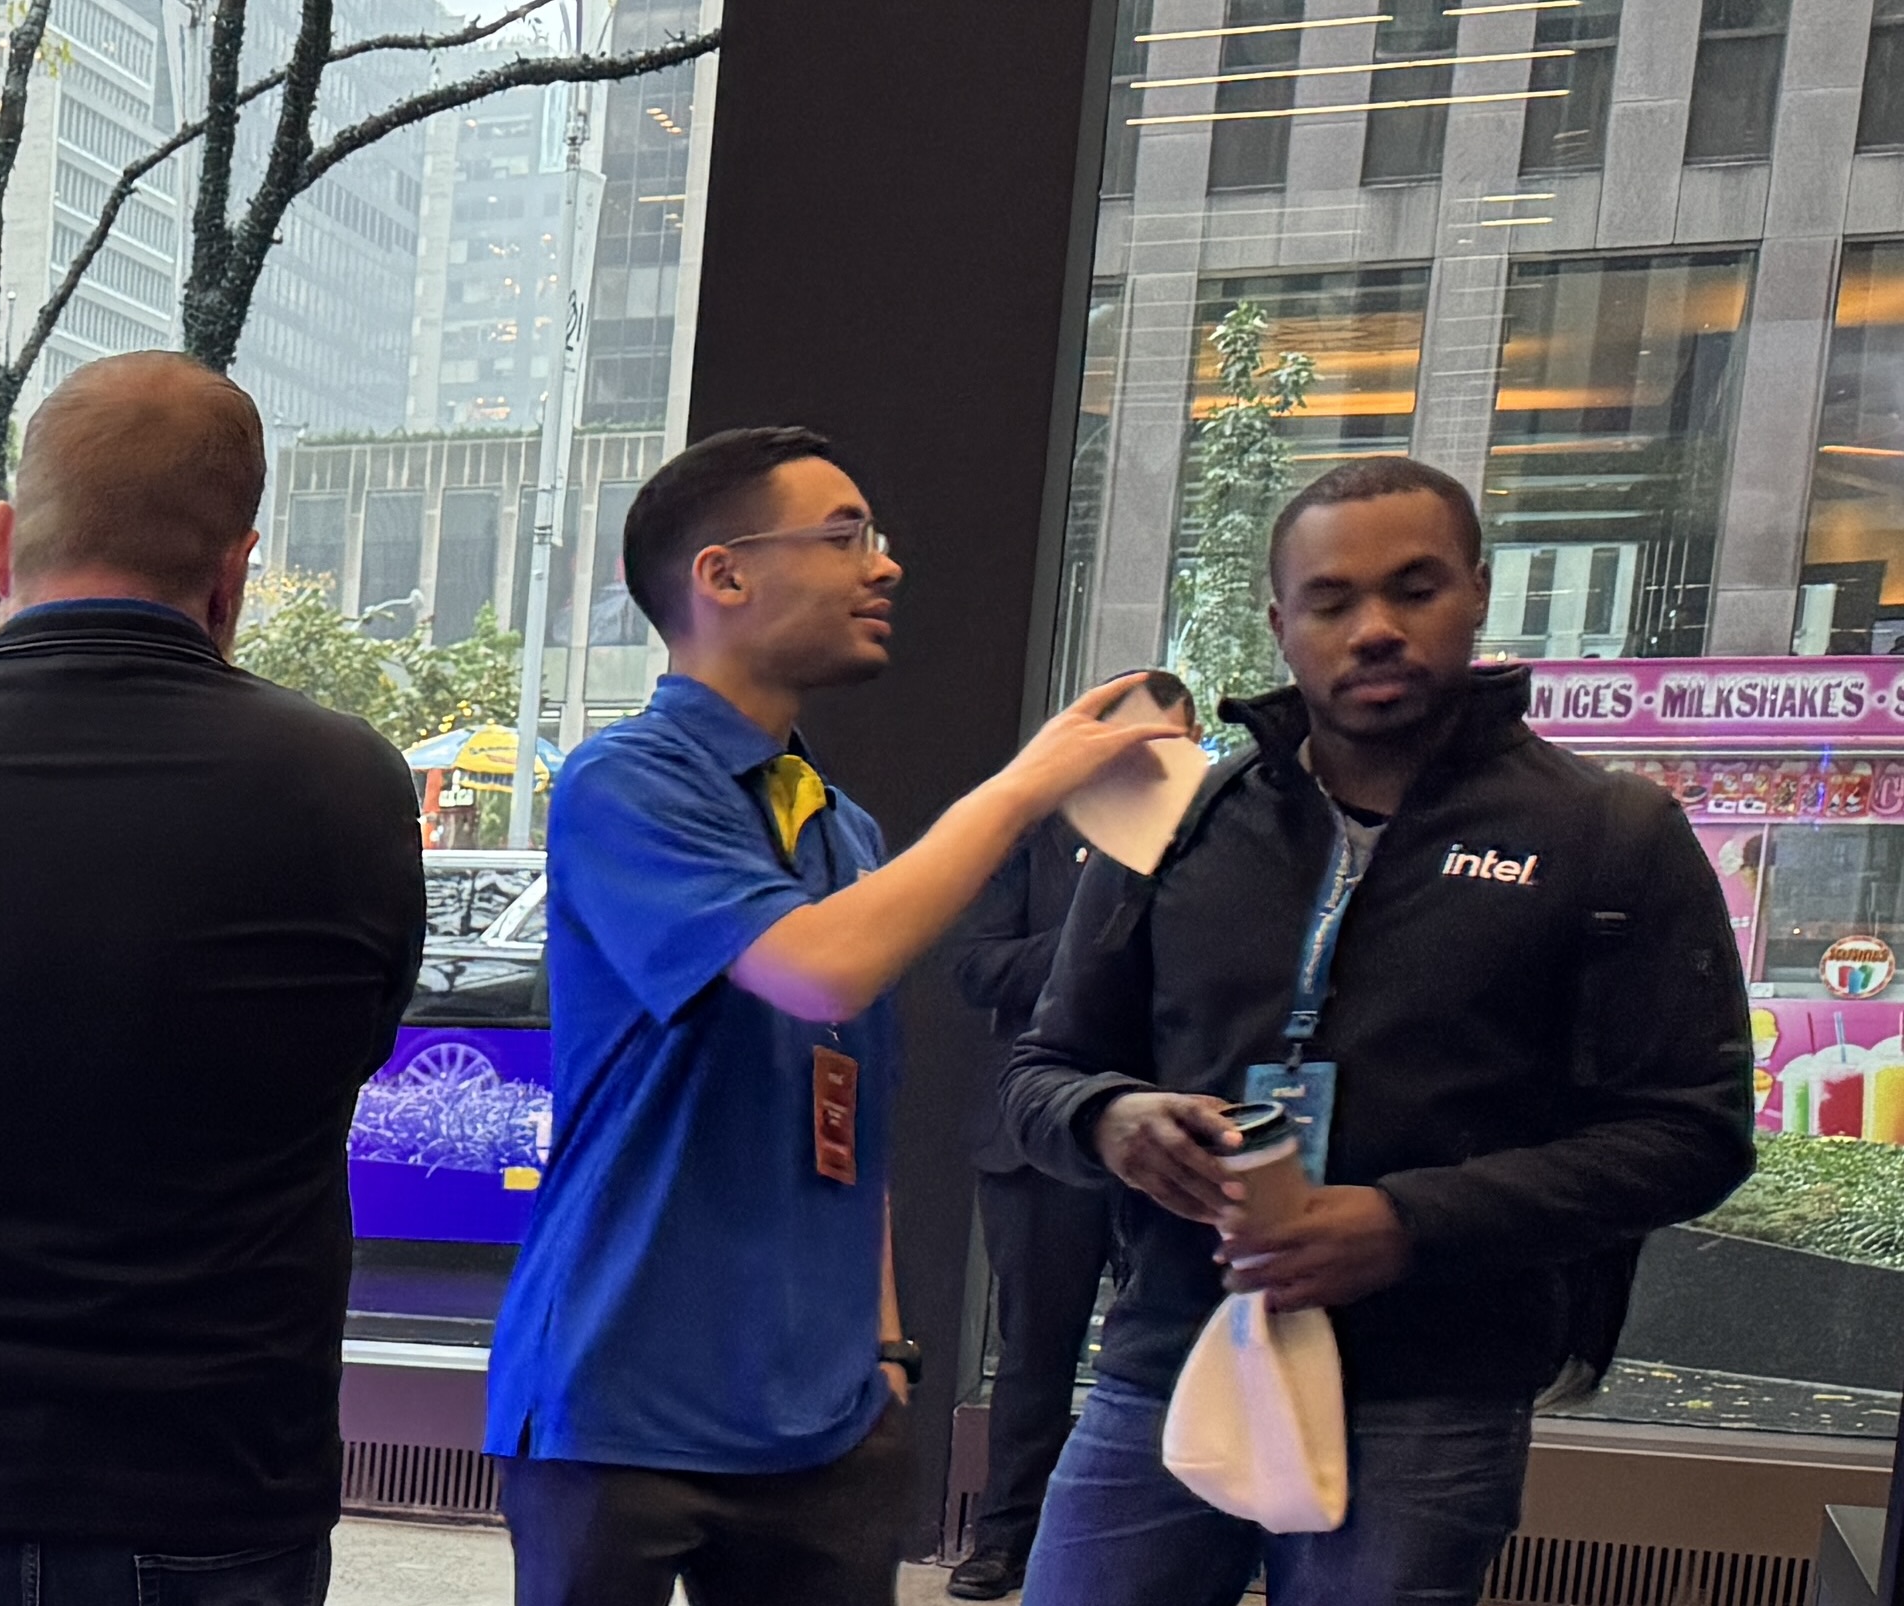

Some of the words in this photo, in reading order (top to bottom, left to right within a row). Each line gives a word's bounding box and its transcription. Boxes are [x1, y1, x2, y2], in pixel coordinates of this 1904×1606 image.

[1561, 676, 1633, 719] ICES
[1660, 676, 1866, 719] MILKSHAKES
[1441, 843, 1538, 886] intel
